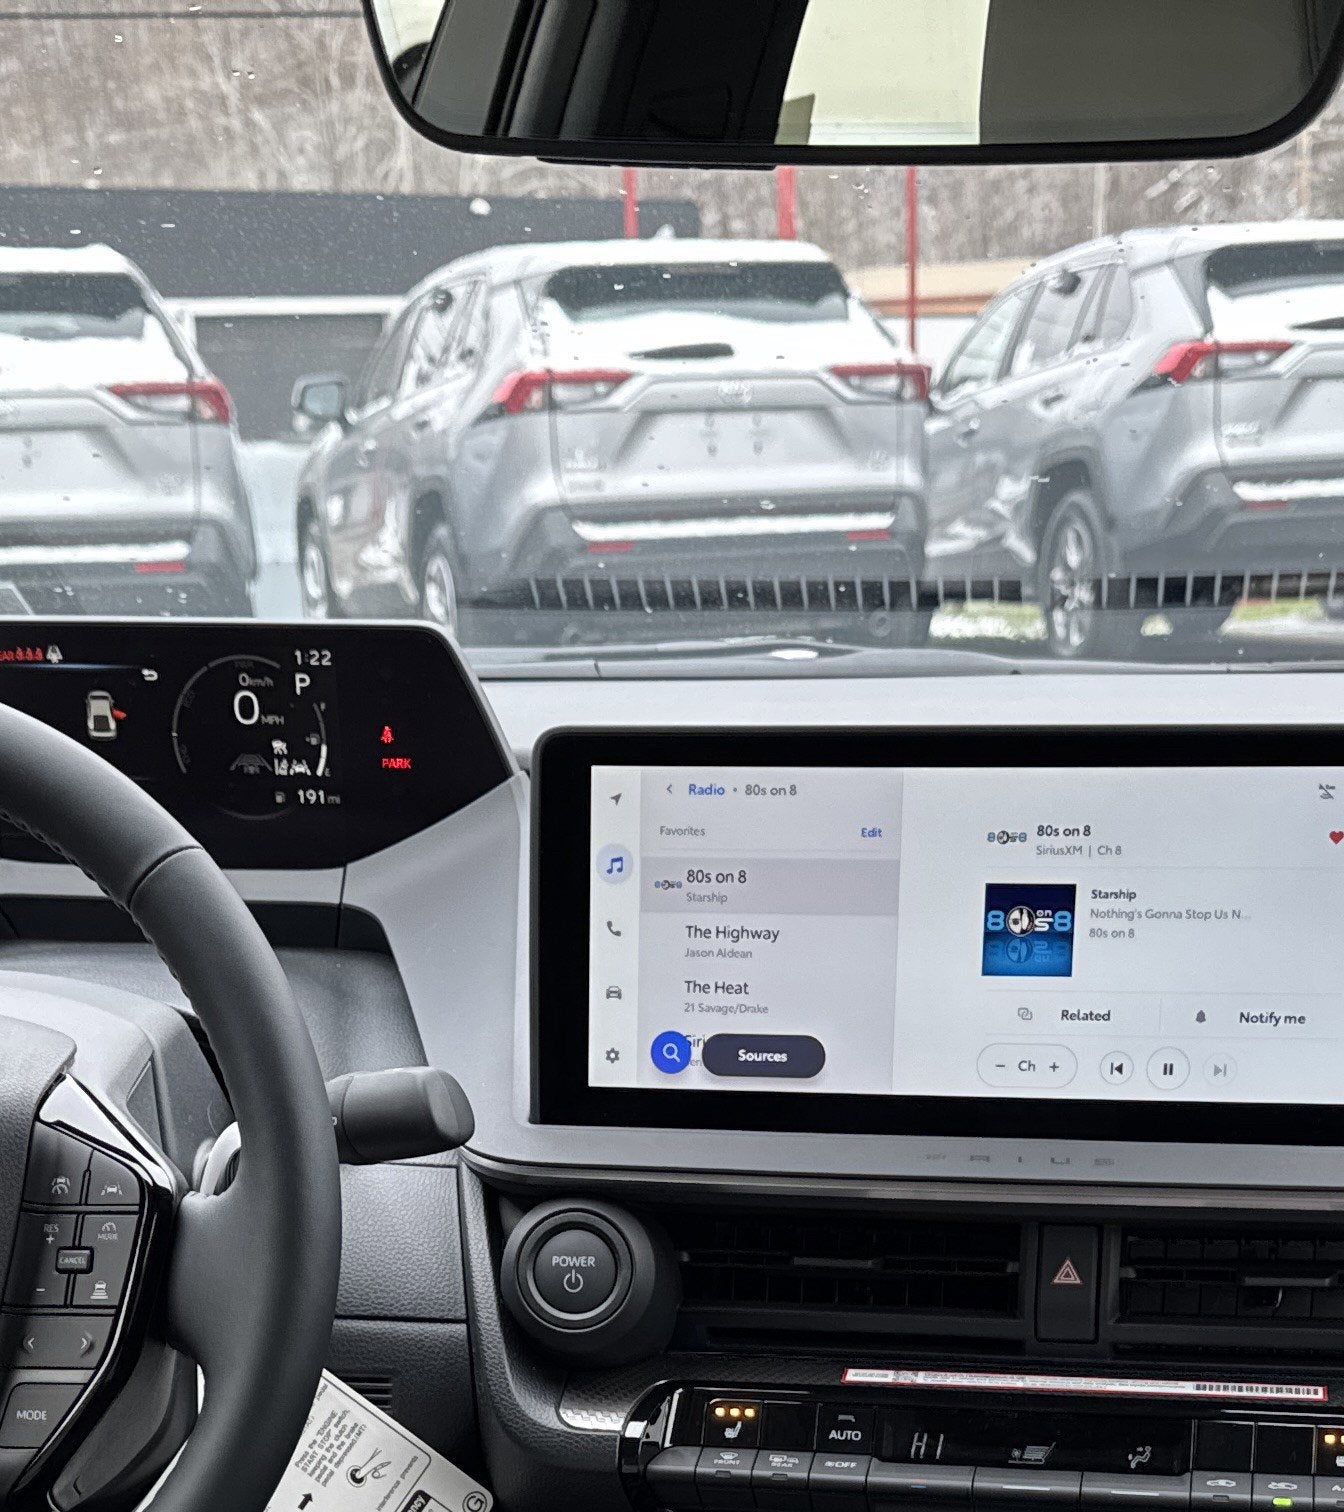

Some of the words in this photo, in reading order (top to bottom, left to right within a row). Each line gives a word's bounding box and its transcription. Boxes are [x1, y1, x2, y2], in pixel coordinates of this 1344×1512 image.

[294, 649, 332, 666] 1:22
[294, 672, 311, 696] P
[233, 689, 260, 725] 0
[260, 714, 285, 725] MPH
[381, 758, 412, 769] PARK
[297, 789, 325, 805] 191
[688, 782, 726, 797] Radio
[744, 783, 766, 798] 80s
[769, 786, 786, 798] on
[789, 783, 798, 798] 8
[659, 824, 706, 838] Favorites
[860, 826, 883, 839] Edit
[1036, 825, 1060, 838] 80s
[1063, 828, 1081, 838] on
[1083, 825, 1092, 838] 8
[1036, 845, 1083, 857] SiriusXM
[1097, 845, 1114, 857] Ch
[1115, 845, 1123, 857] 8
[686, 869, 712, 884] 80s
[715, 873, 734, 884] on
[737, 870, 748, 884] 8
[686, 891, 728, 905] Starship
[1090, 889, 1138, 902] Starship
[1090, 908, 1143, 922] Nothing's
[1145, 909, 1183, 920] Gonna
[1185, 909, 1212, 922] Stop
[1213, 910, 1229, 920] Us
[685, 925, 712, 940] The
[715, 925, 780, 943] Highway
[1089, 927, 1109, 939] 80s
[1111, 930, 1126, 939] on
[1127, 928, 1136, 939] 8
[685, 947, 712, 960] Jason
[714, 947, 753, 960] Aldean
[684, 980, 712, 996] The
[714, 980, 750, 996] Heat
[684, 1003, 696, 1014] 21
[1060, 1008, 1112, 1023] Related
[1238, 1011, 1279, 1027] Notify
[1280, 1013, 1307, 1026] me
[737, 1048, 788, 1063] Sources
[1017, 1059, 1036, 1074] Ch
[551, 1254, 596, 1269] POWER
[16, 1409, 48, 1422] MODE
[829, 1430, 862, 1442] AUTO
[713, 1458, 741, 1466] FRONT
